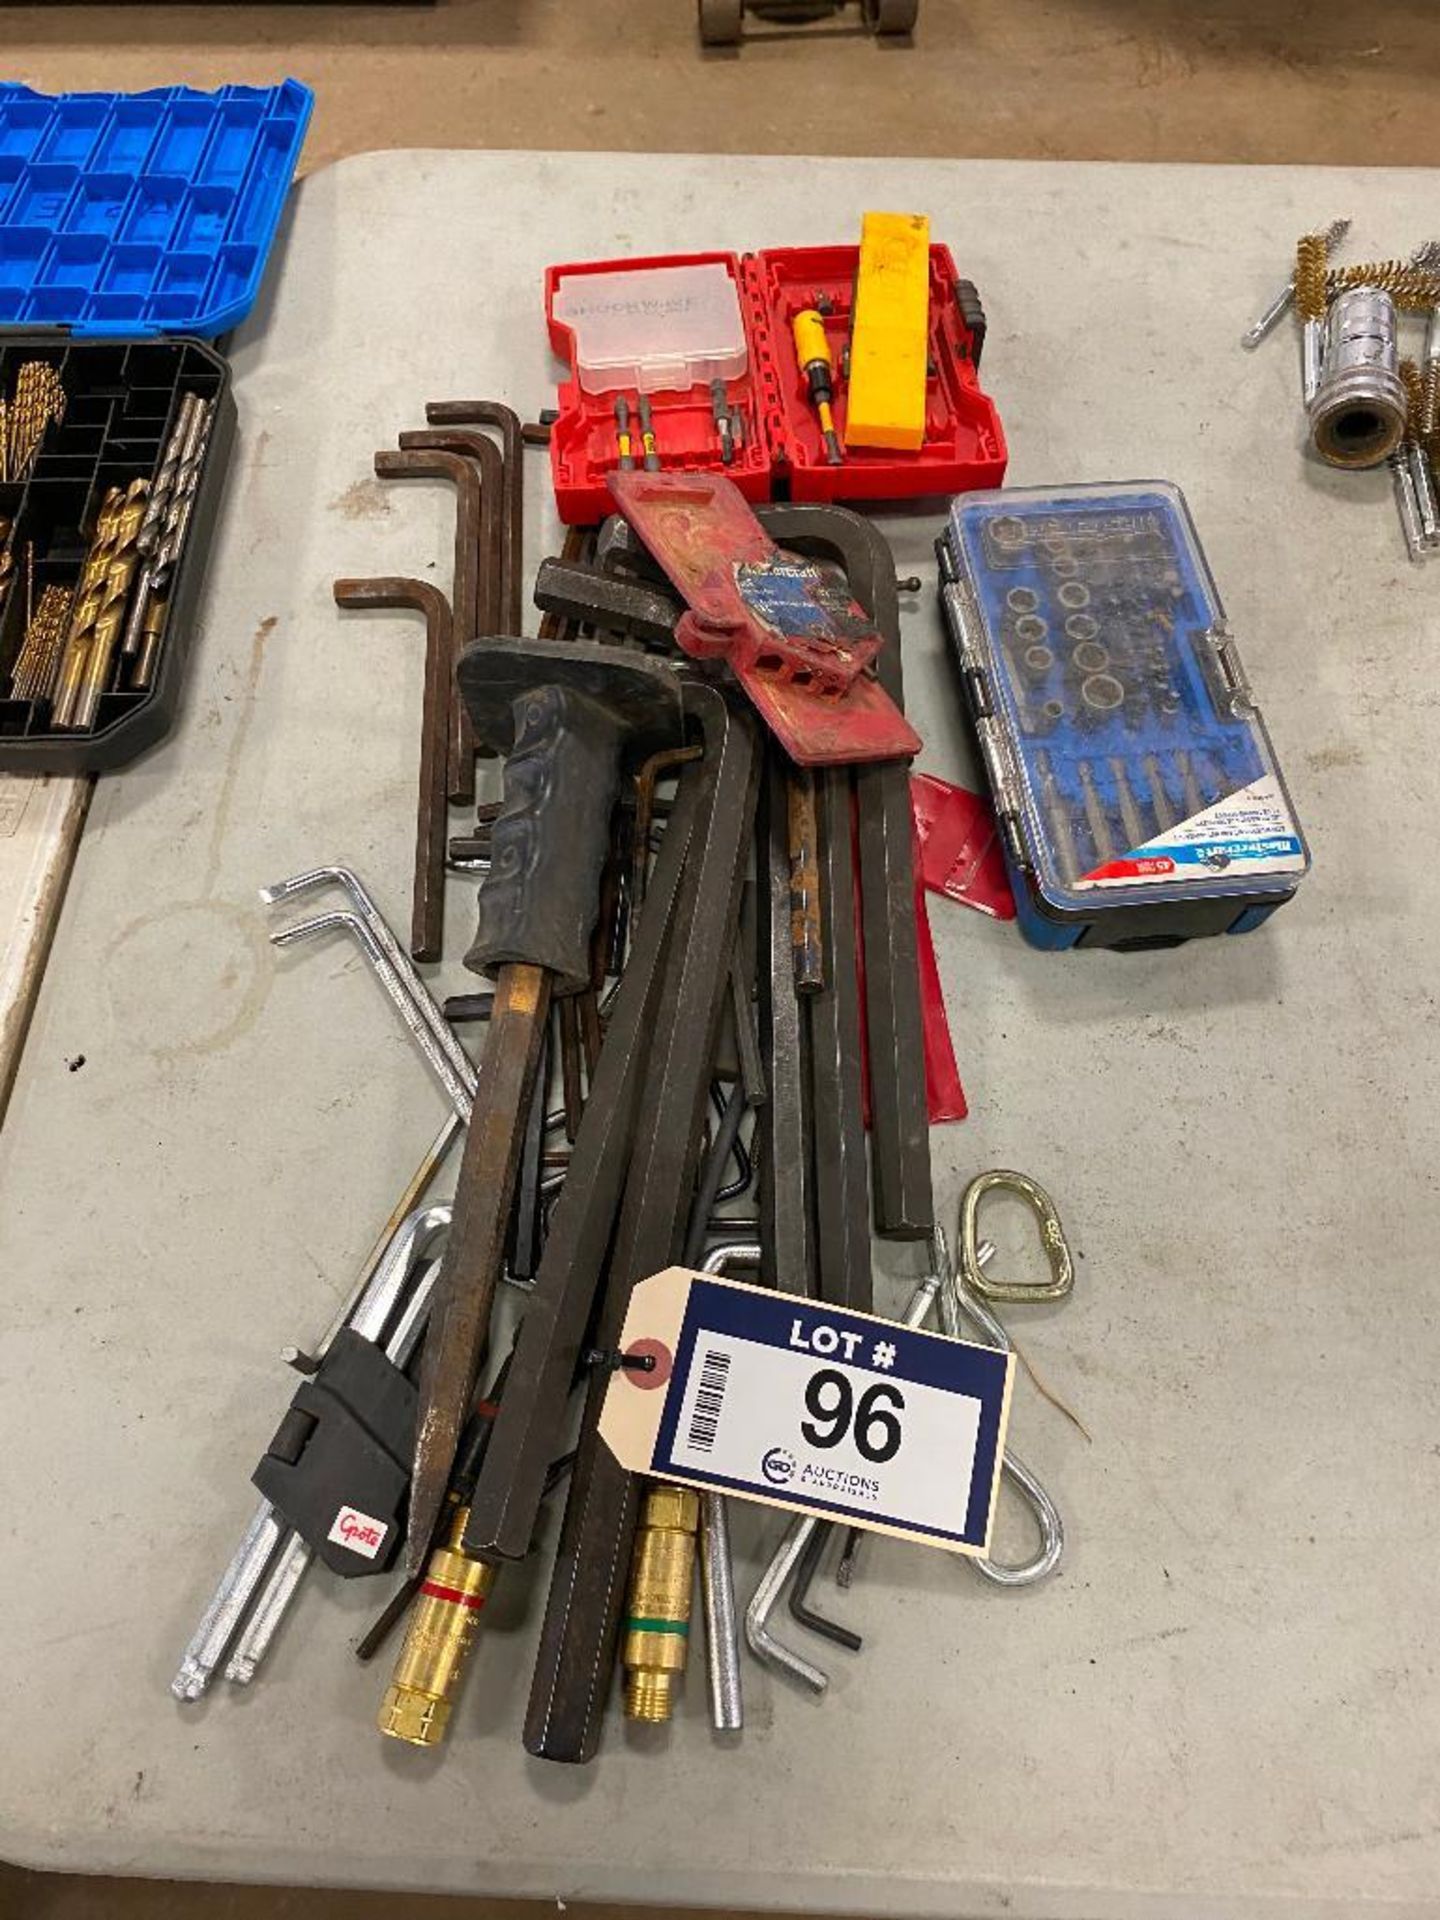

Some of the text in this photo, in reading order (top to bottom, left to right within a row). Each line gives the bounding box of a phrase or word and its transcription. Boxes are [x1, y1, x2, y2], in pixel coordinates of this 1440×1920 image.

[790, 1319, 897, 1369] LOT #
[801, 1369, 905, 1463] 96
[803, 1464, 880, 1492] AUCTIONS
[340, 1514, 381, 1546] Grote
